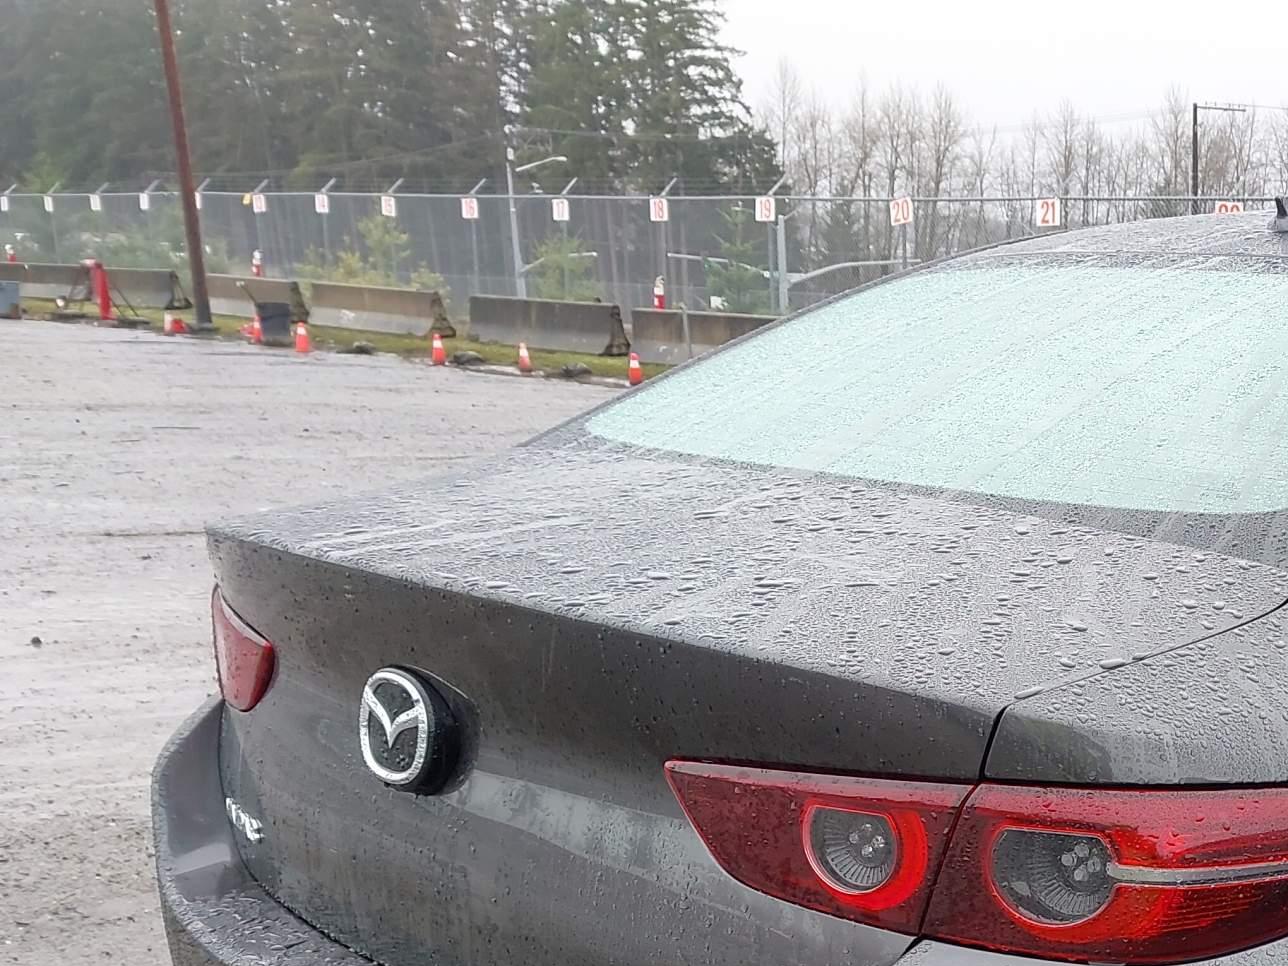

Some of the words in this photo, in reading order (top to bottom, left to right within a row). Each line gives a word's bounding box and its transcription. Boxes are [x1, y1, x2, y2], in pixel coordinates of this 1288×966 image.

[464, 199, 476, 217] 16
[556, 200, 565, 219] 17
[653, 200, 664, 219] 18
[760, 199, 771, 219] 19
[892, 199, 909, 223] 20
[1041, 201, 1056, 225] 21
